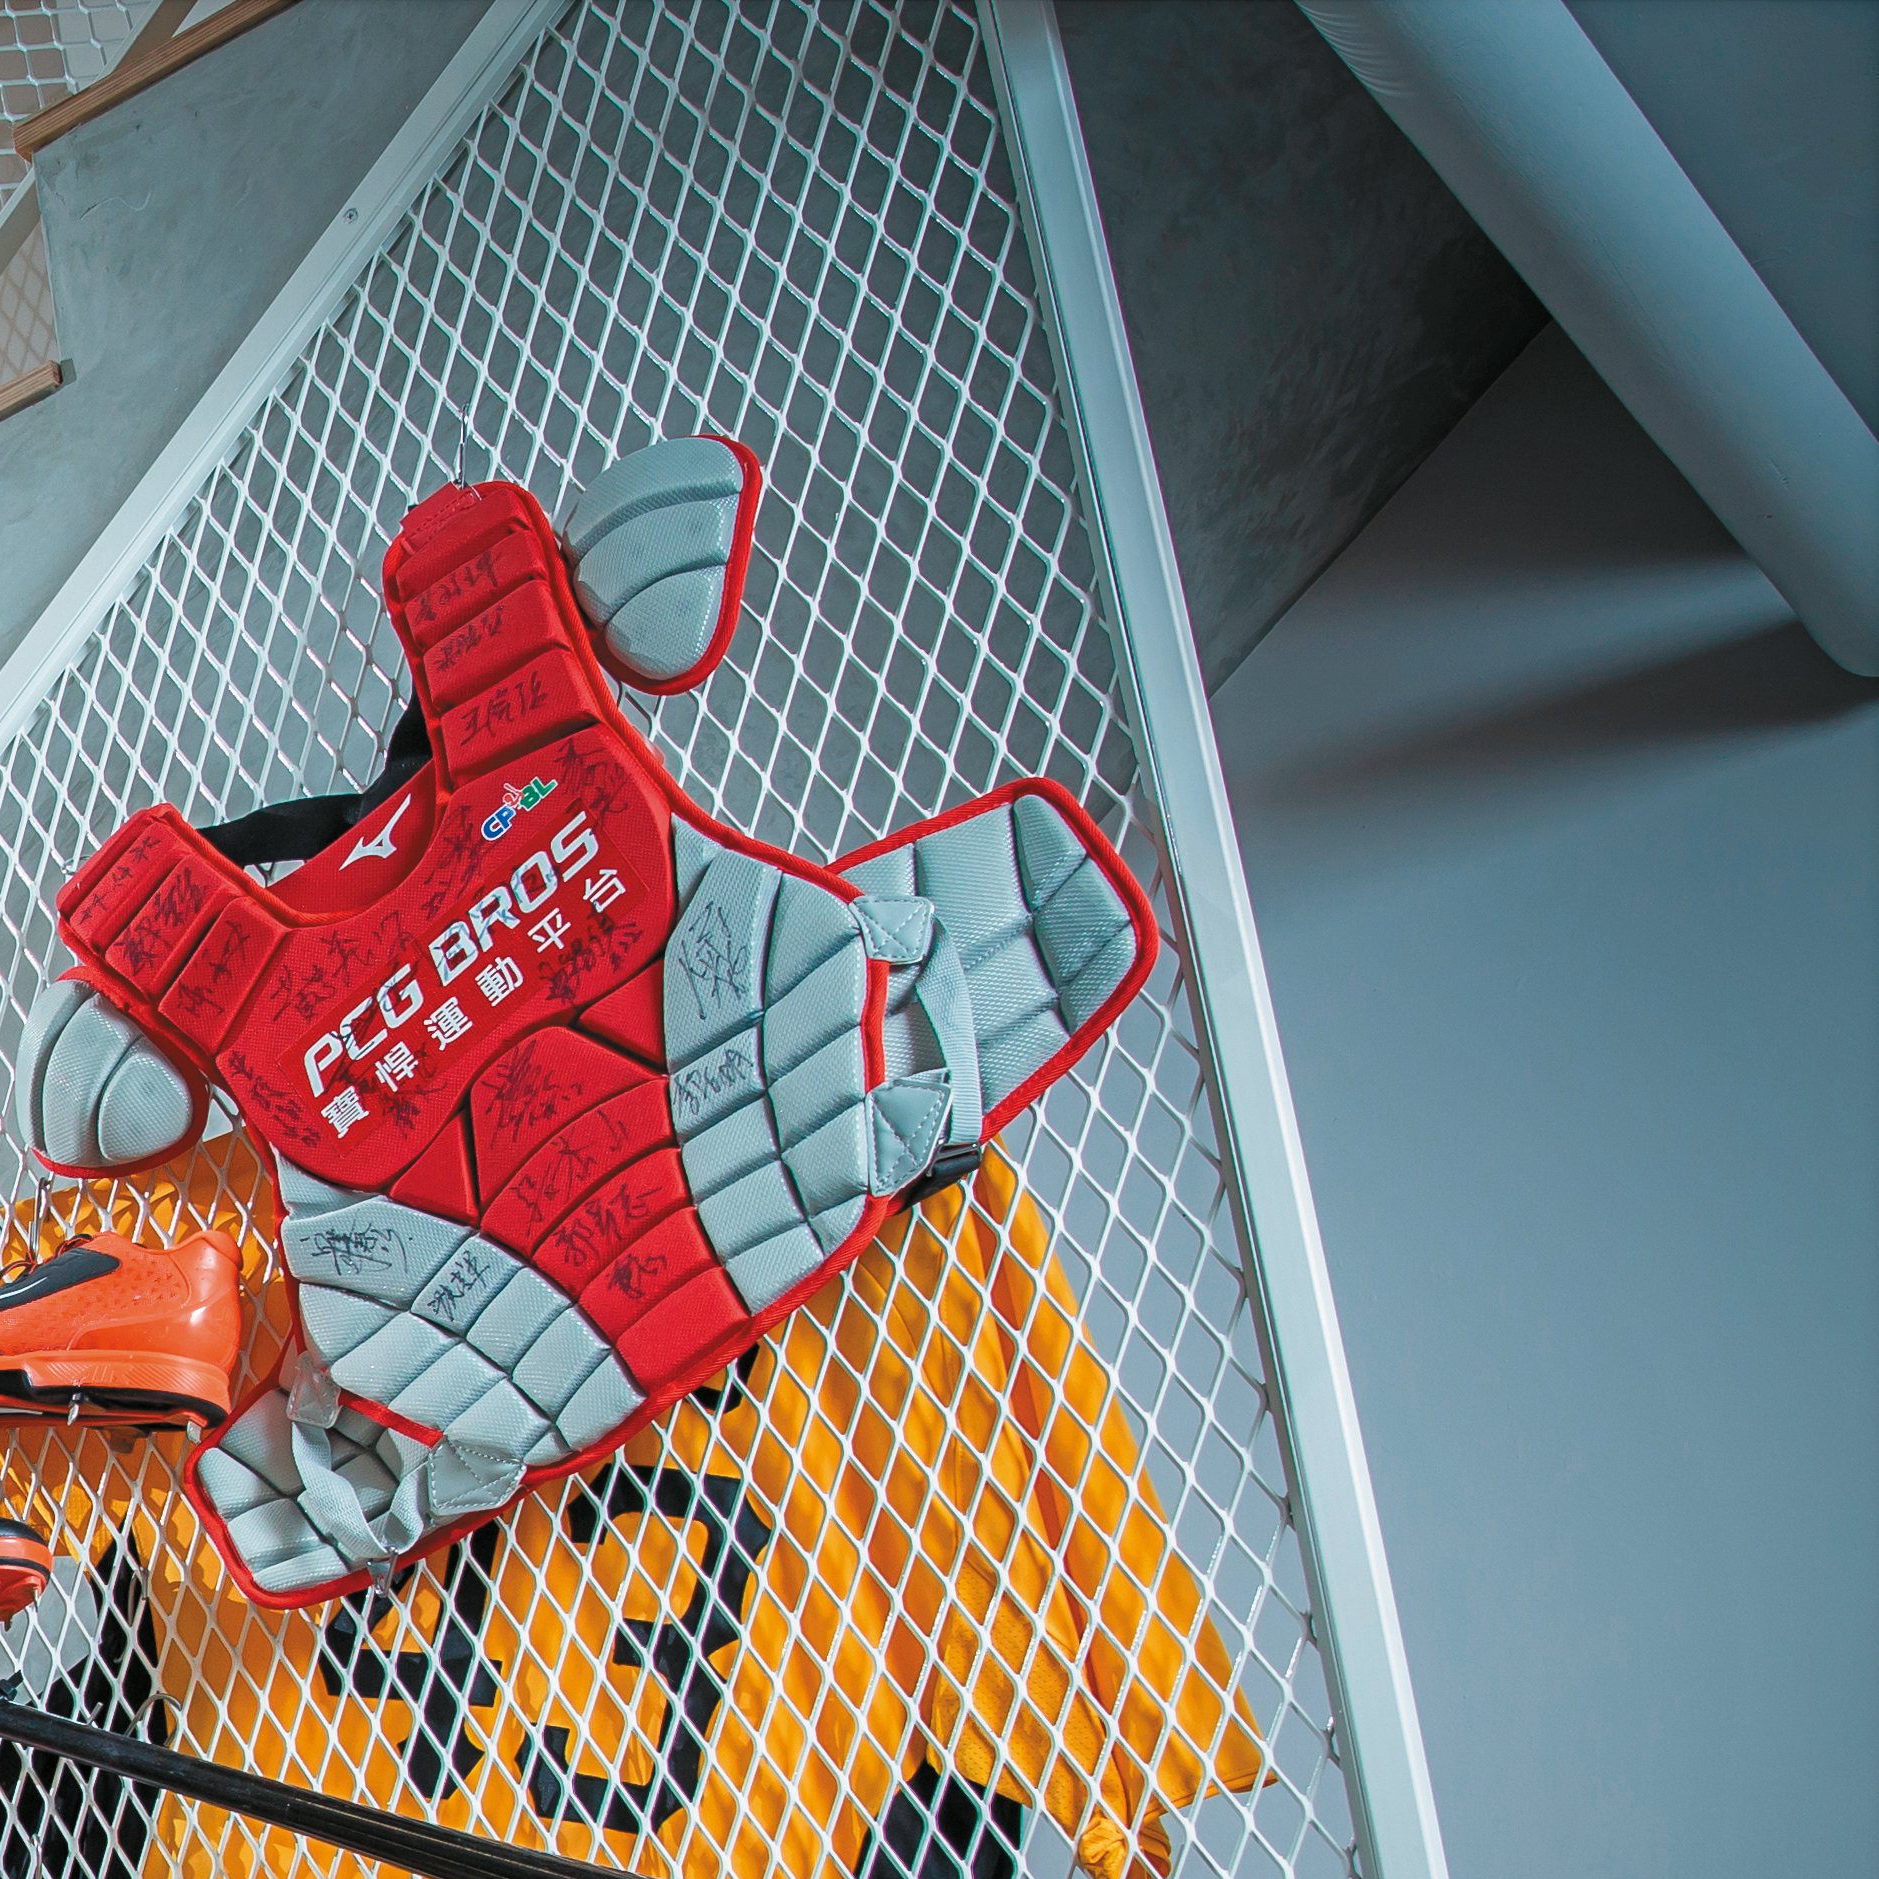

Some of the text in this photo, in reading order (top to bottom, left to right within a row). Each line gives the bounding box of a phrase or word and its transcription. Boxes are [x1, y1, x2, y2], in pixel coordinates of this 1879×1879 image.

[481, 776, 558, 841] CPBL
[304, 963, 424, 1098] PCG
[428, 811, 599, 987] BROS
[320, 868, 626, 1139] 寶悍運動平台
